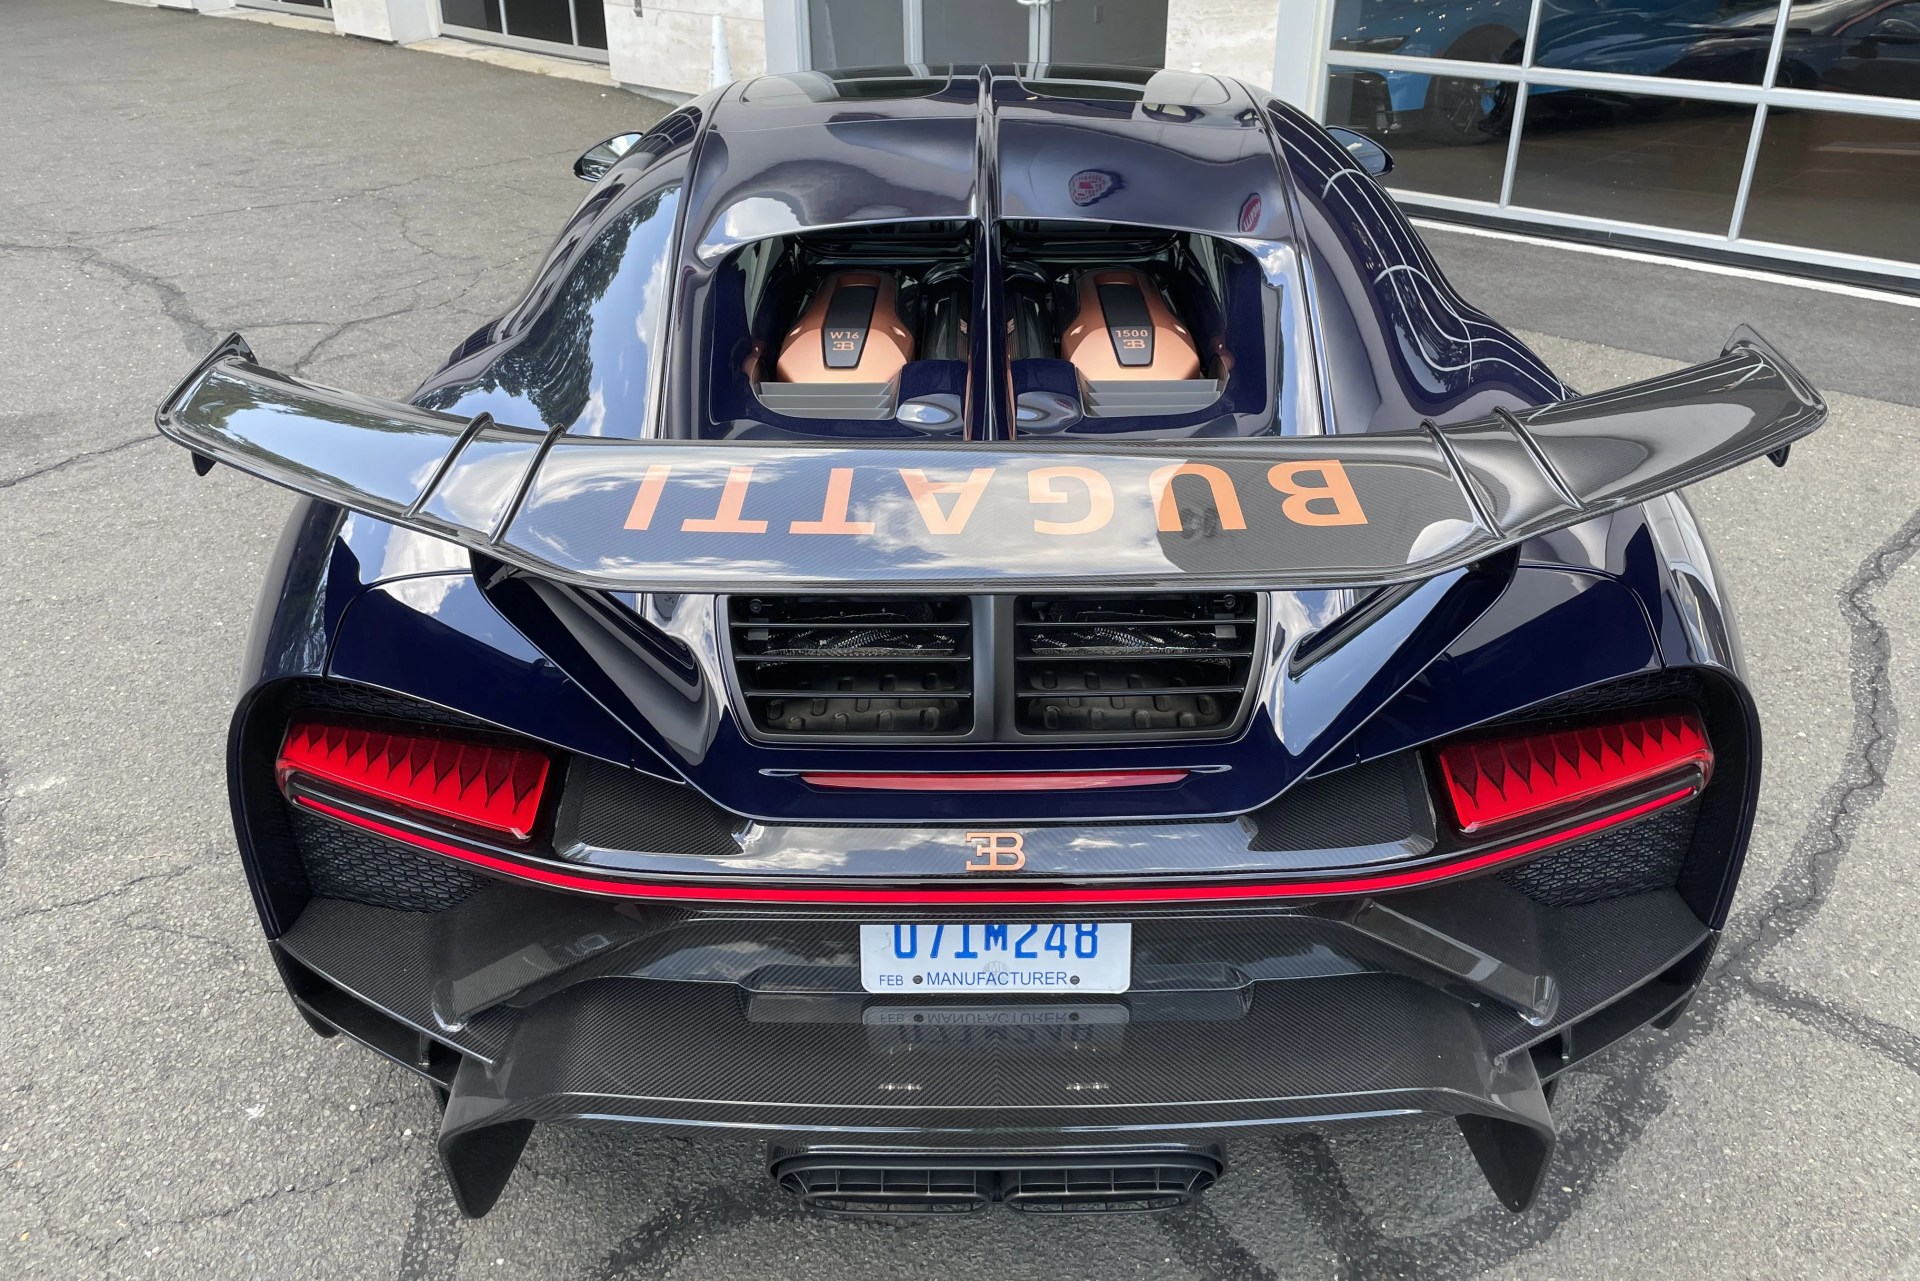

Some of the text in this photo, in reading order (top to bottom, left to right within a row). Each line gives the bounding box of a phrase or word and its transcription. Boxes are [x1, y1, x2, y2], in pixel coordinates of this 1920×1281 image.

[830, 331, 860, 339] W16
[1116, 329, 1149, 337] 1500
[623, 459, 1369, 535] BUGATTI
[879, 972, 1068, 986] FEB MANUFACTURER
